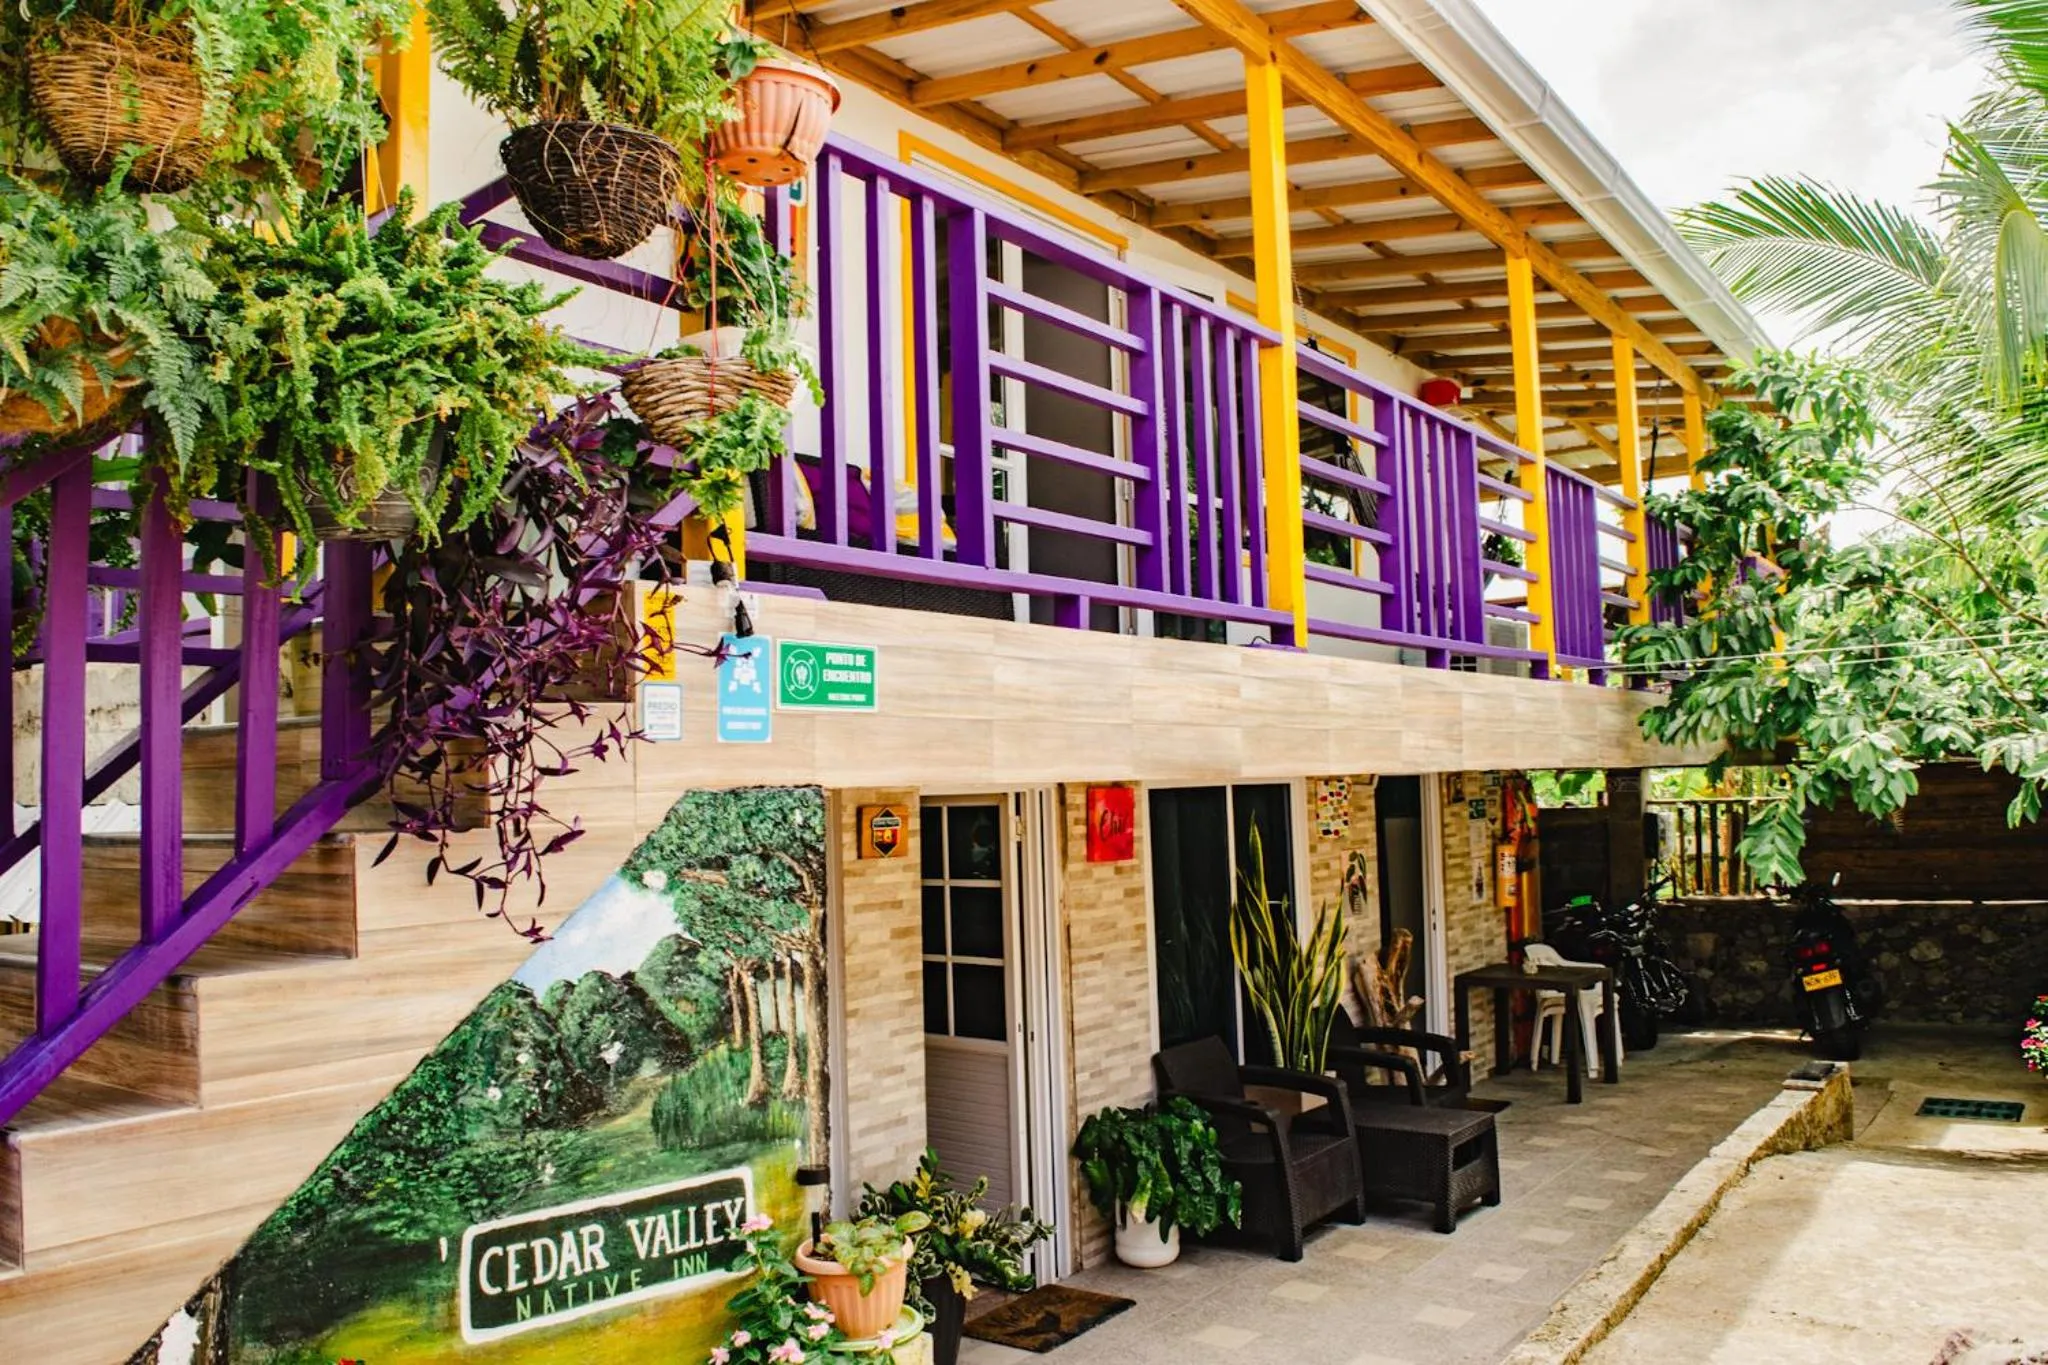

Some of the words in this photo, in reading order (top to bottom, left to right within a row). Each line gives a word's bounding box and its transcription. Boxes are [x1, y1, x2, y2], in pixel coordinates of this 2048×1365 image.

[822, 669, 872, 684] ENCUENTRO
[825, 652, 854, 666] PUNTO
[855, 653, 868, 667] DE
[478, 1223, 610, 1296] CEDAR
[626, 1197, 745, 1261] VALLEY
[515, 1267, 643, 1322] NATIVE
[673, 1251, 708, 1279] INN
